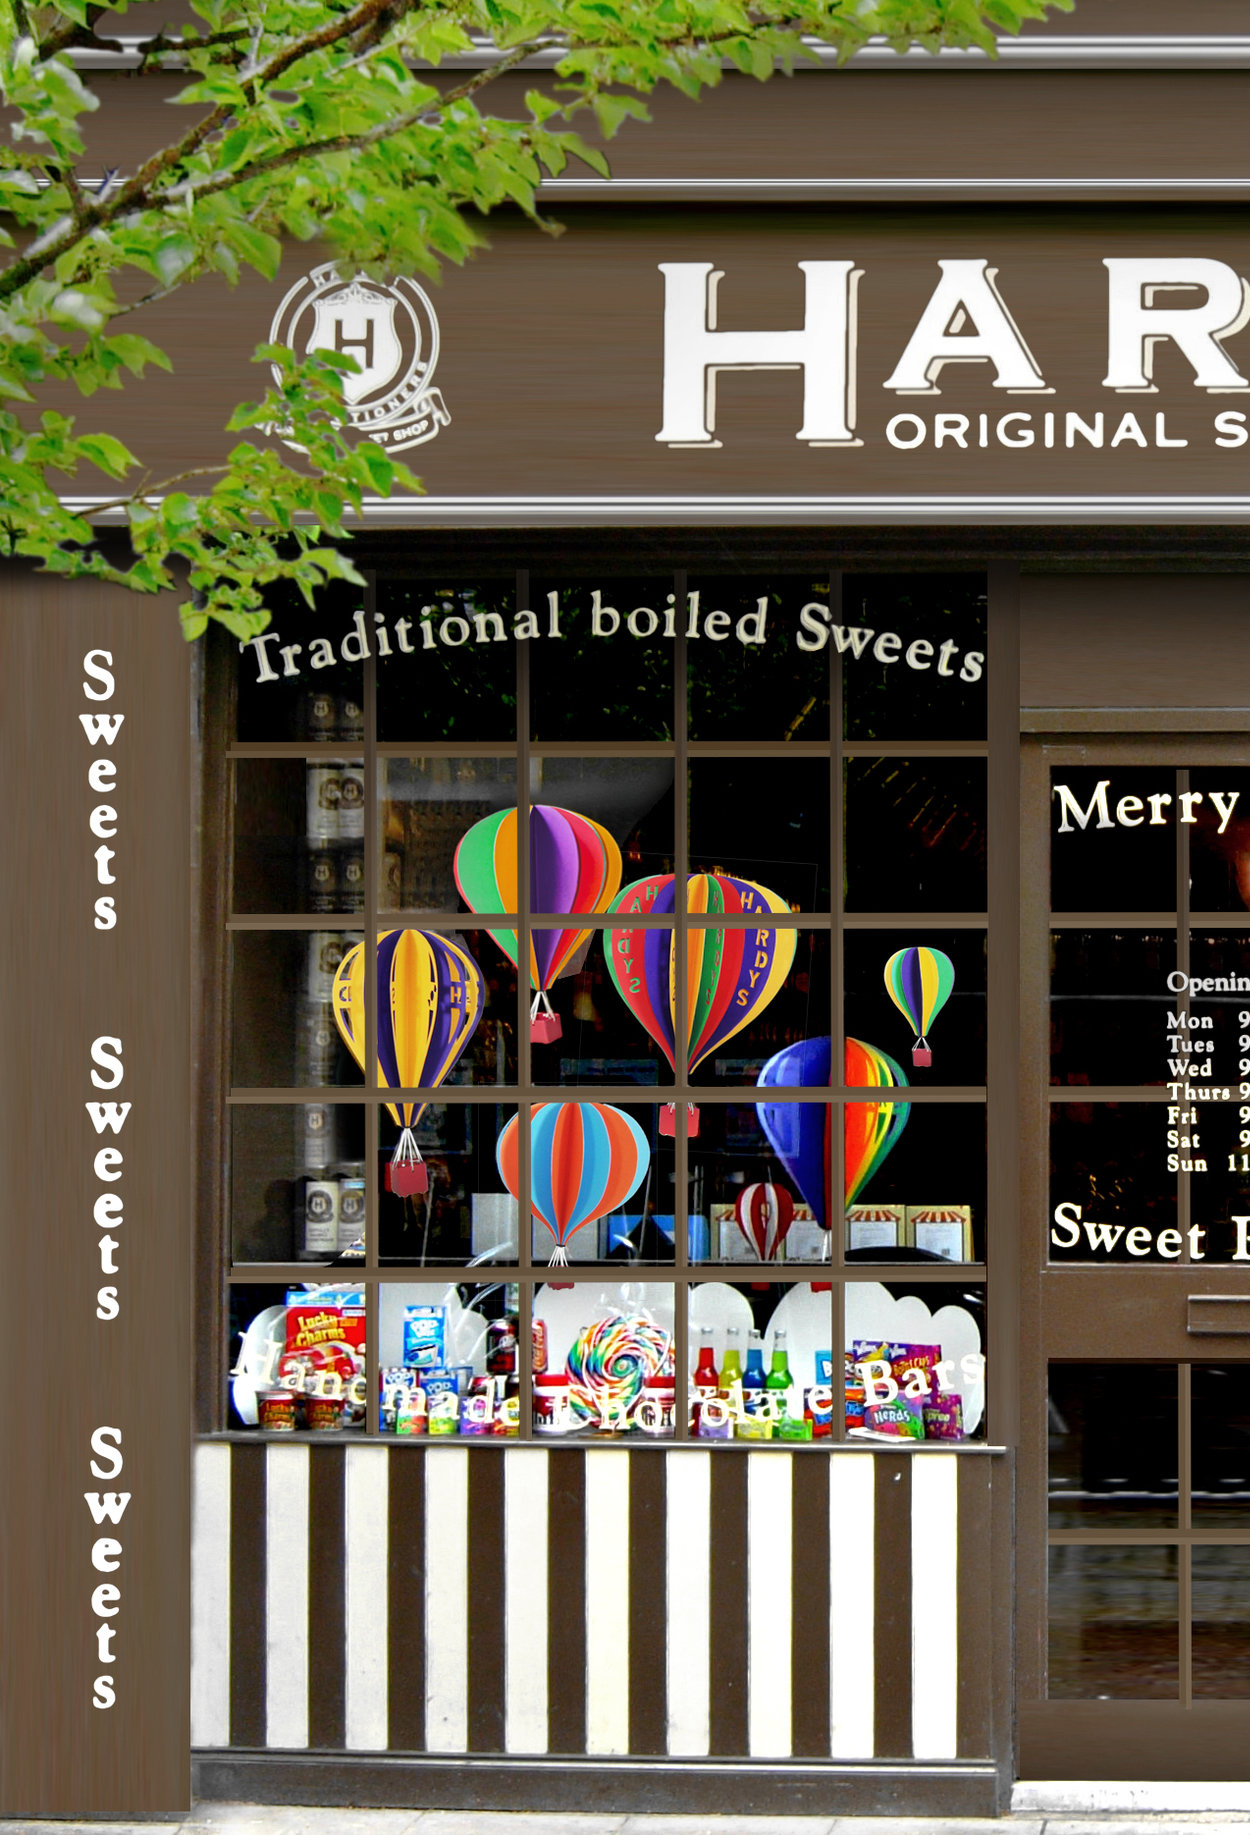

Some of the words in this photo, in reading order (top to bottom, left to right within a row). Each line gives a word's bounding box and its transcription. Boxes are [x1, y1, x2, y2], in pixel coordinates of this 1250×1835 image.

[335, 319, 374, 368] H
[884, 411, 1189, 450] ORIGINAL
[239, 590, 561, 682] Traditional
[591, 590, 768, 645] boiled
[796, 603, 985, 682] Sweets
[78, 649, 125, 931] Sweets
[1053, 780, 1240, 834] Merry
[1166, 1010, 1214, 1029] Mon
[1166, 1034, 1215, 1053] Tues
[1166, 1058, 1212, 1077] Wed
[1166, 1082, 1231, 1101] Thurs
[1166, 1106, 1197, 1125] Fri
[1166, 1130, 1200, 1149] Sat
[1166, 1154, 1208, 1173] Sun
[85, 1035, 132, 1322] Sweets
[1050, 1202, 1207, 1262] Sweet
[298, 1312, 338, 1331] Lucky
[295, 1327, 346, 1347] Charms
[854, 1352, 987, 1407] Bars
[83, 1425, 132, 1711] Sweets
